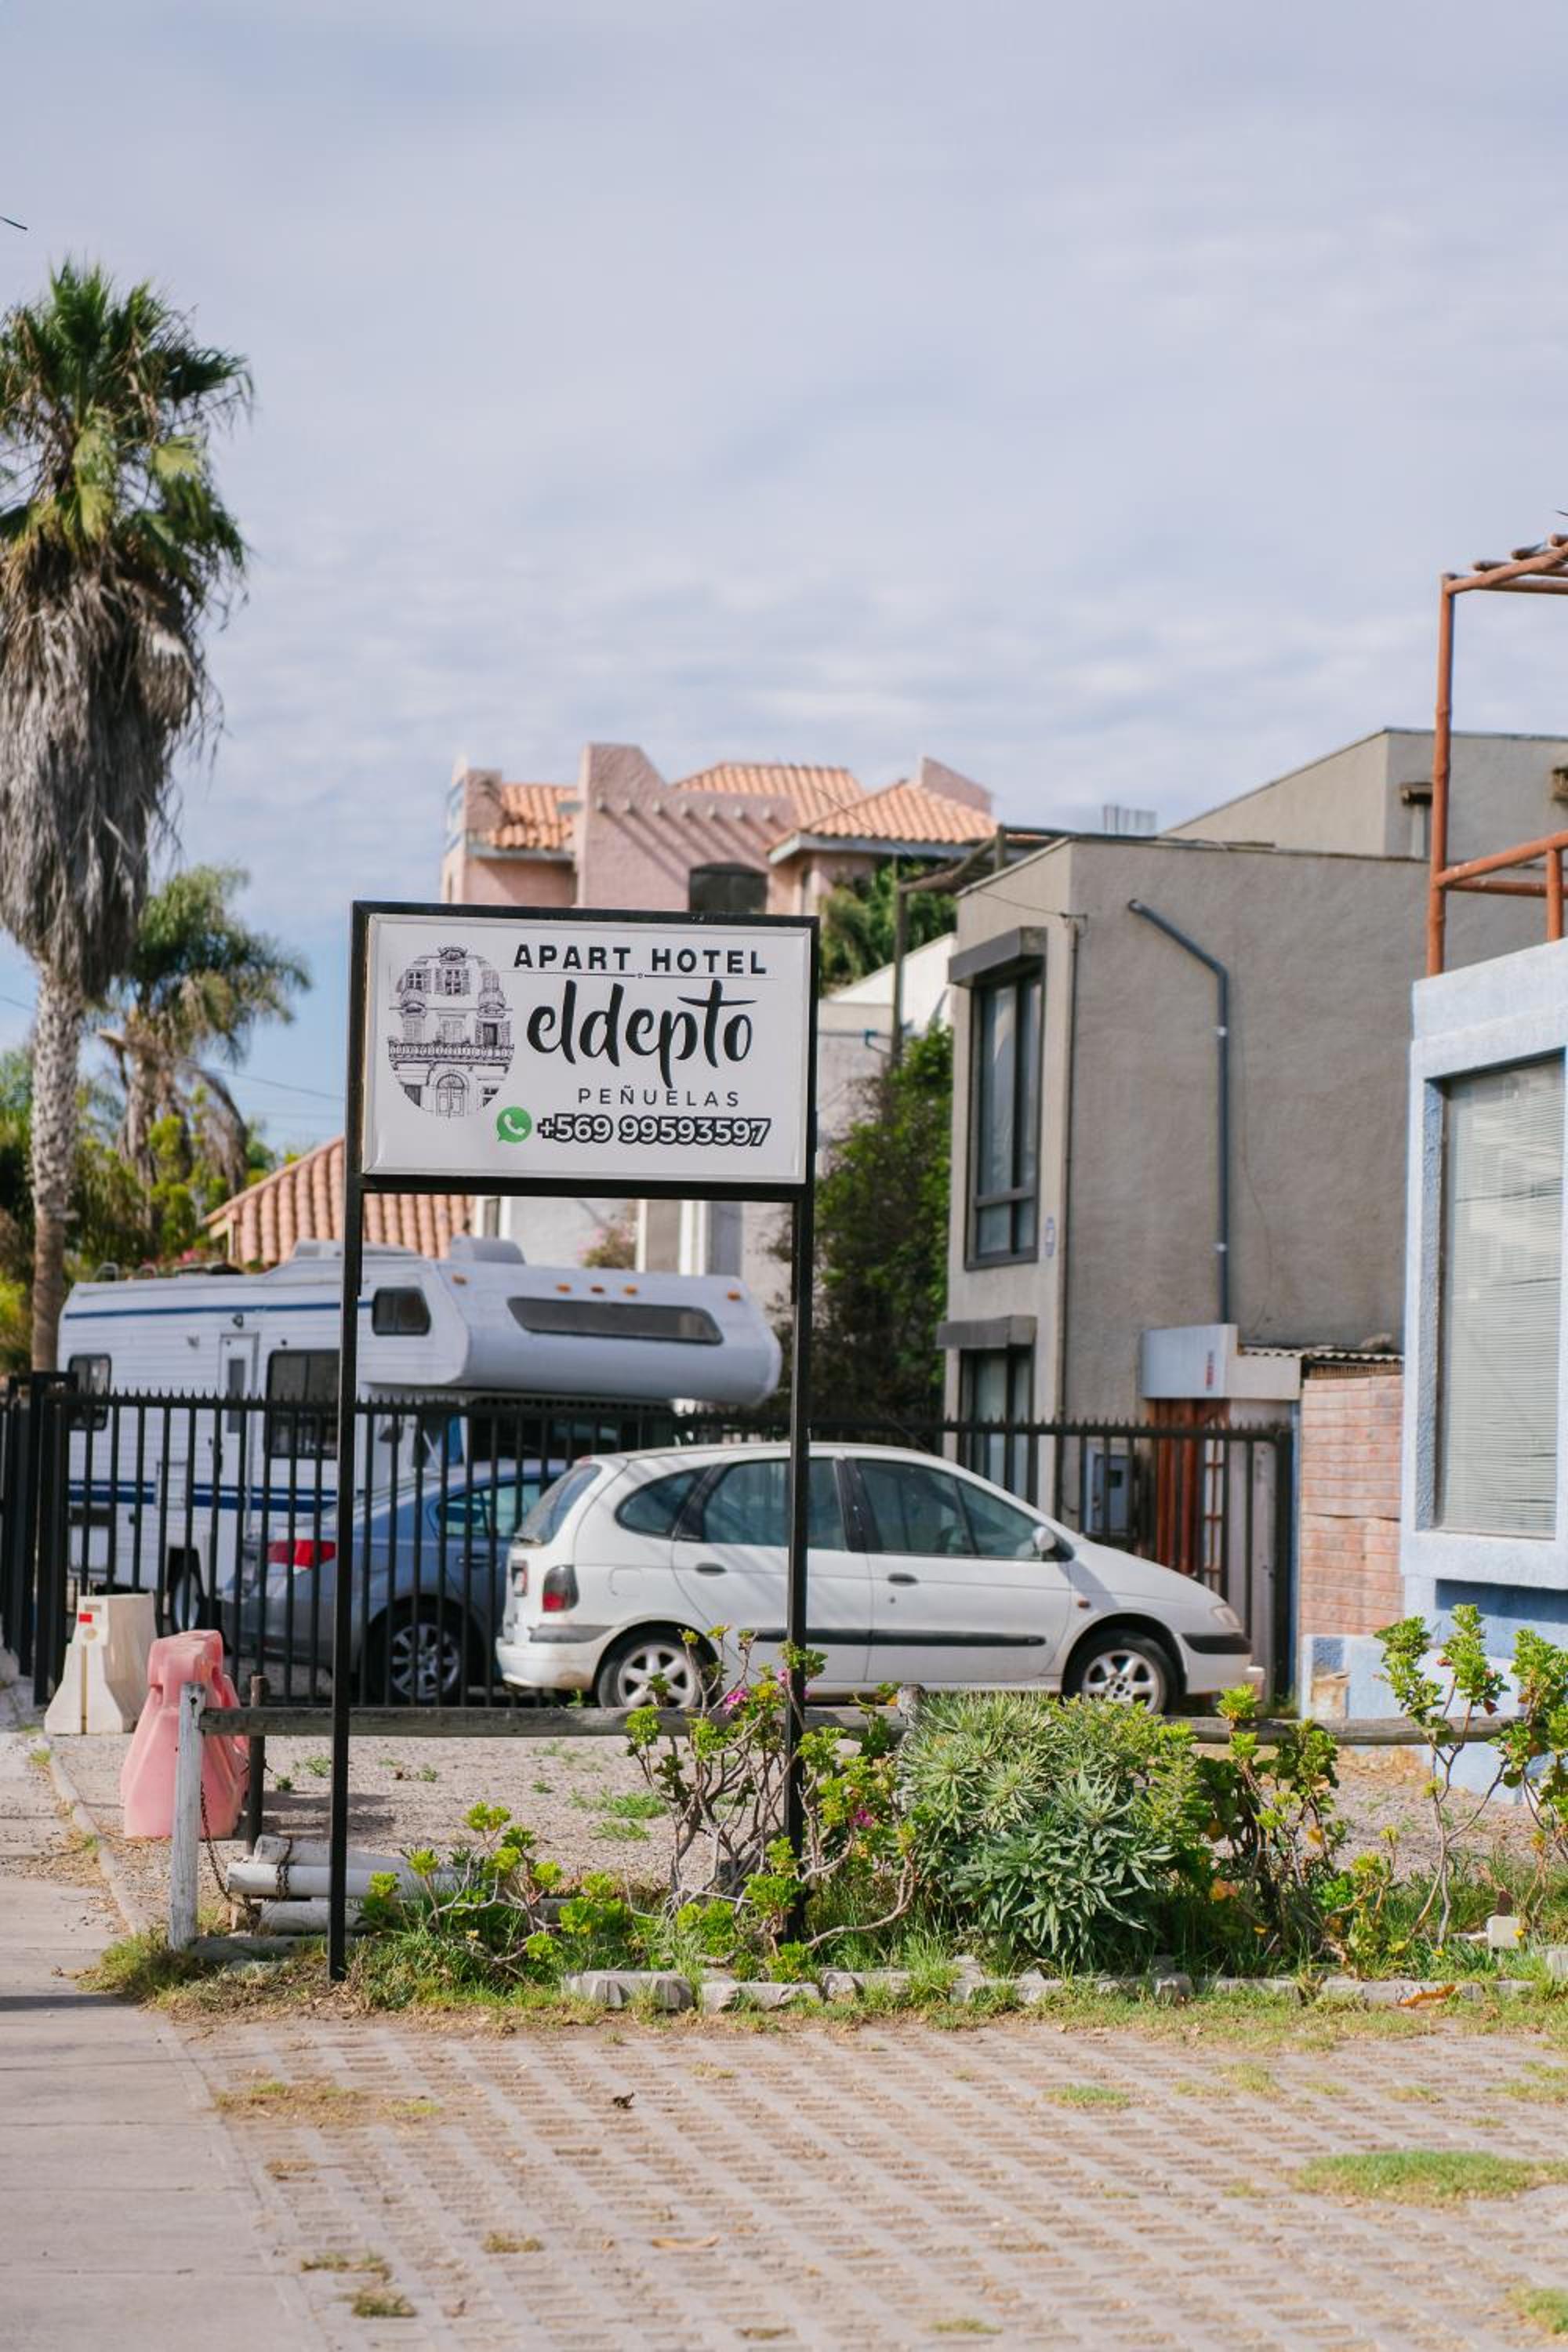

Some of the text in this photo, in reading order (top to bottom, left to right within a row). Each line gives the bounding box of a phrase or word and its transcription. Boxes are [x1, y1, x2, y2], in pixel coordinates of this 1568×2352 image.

[514, 943, 767, 975] APART HOTEL
[526, 978, 757, 1090] eldepto
[578, 1085, 739, 1107] PEÑUELAS
[537, 1112, 771, 1147] +569 99593597
